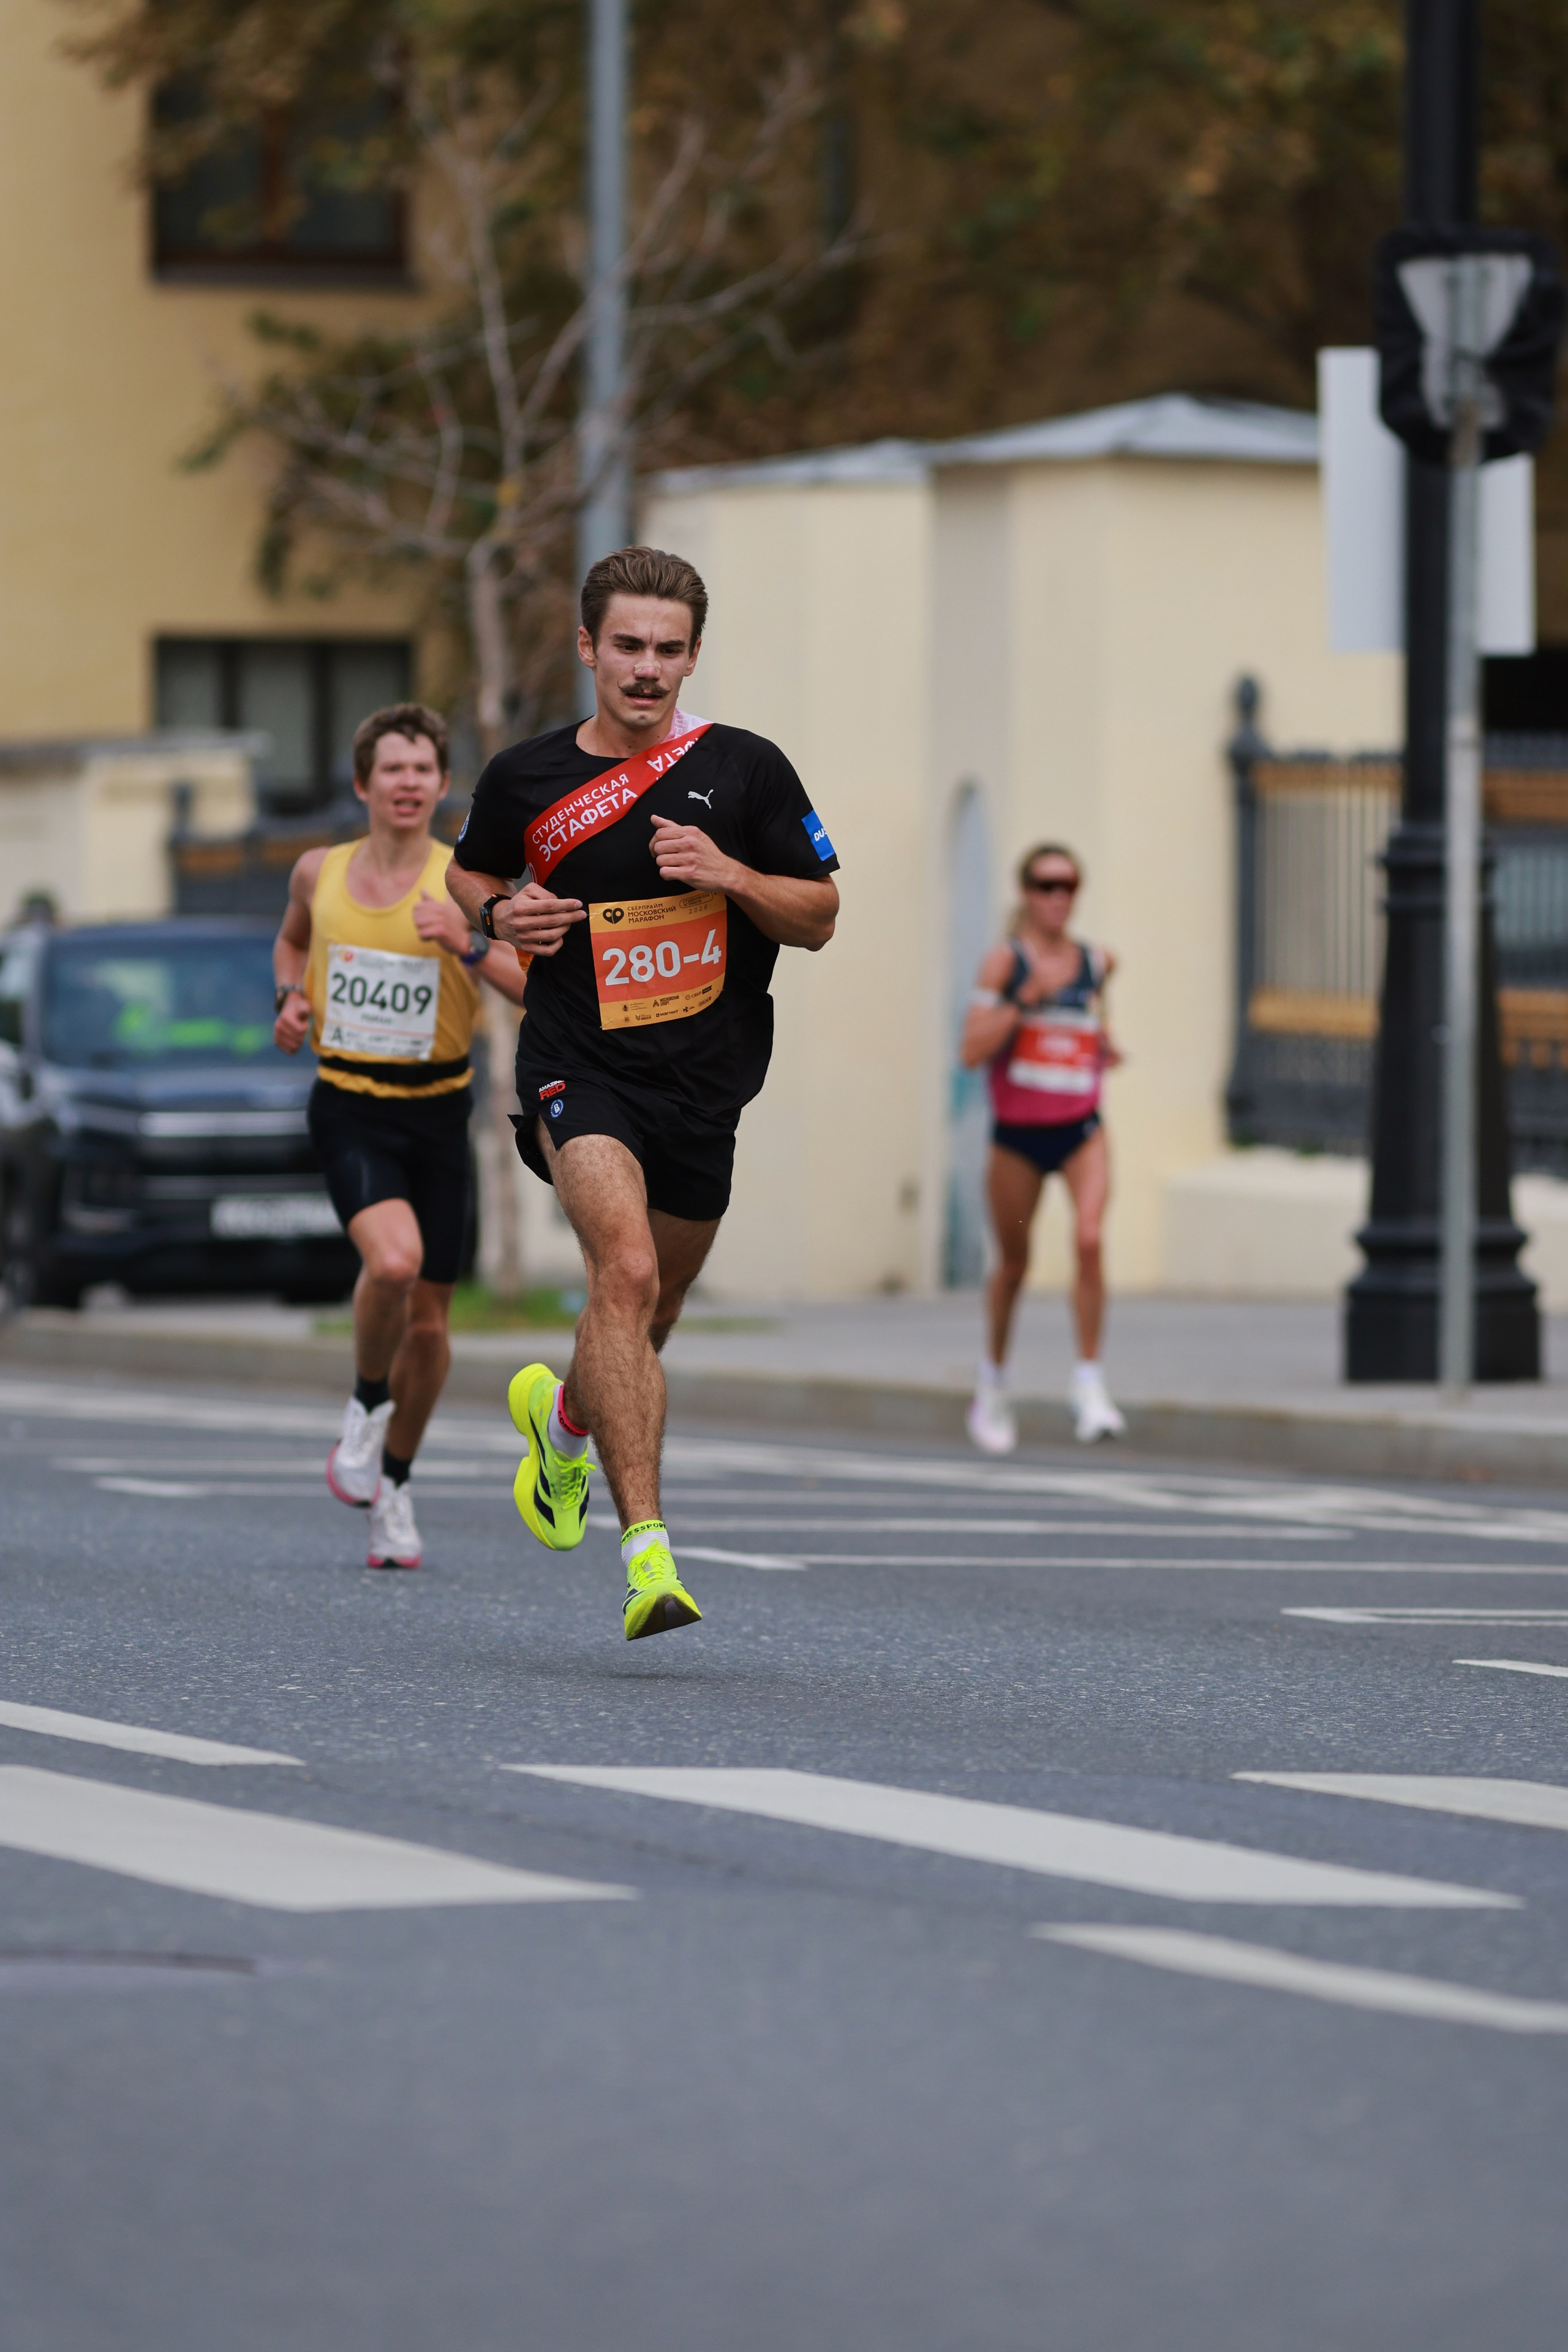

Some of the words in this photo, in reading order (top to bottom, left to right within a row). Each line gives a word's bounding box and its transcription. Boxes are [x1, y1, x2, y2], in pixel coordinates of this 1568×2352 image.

[647, 737, 698, 772] ФЕТА
[532, 773, 630, 845] СТУДЕНЧЕСКАЯ
[538, 788, 638, 862] ЭСТАФЕТА
[813, 827, 827, 842] DU
[627, 903, 663, 911] СБЕРПРАЙМ
[628, 906, 676, 918] МОСКОВСКИЙ
[628, 914, 665, 924] МАРАФОН
[602, 929, 722, 986] 280-4
[331, 971, 432, 1016] 20409
[539, 1082, 566, 1101] RED
